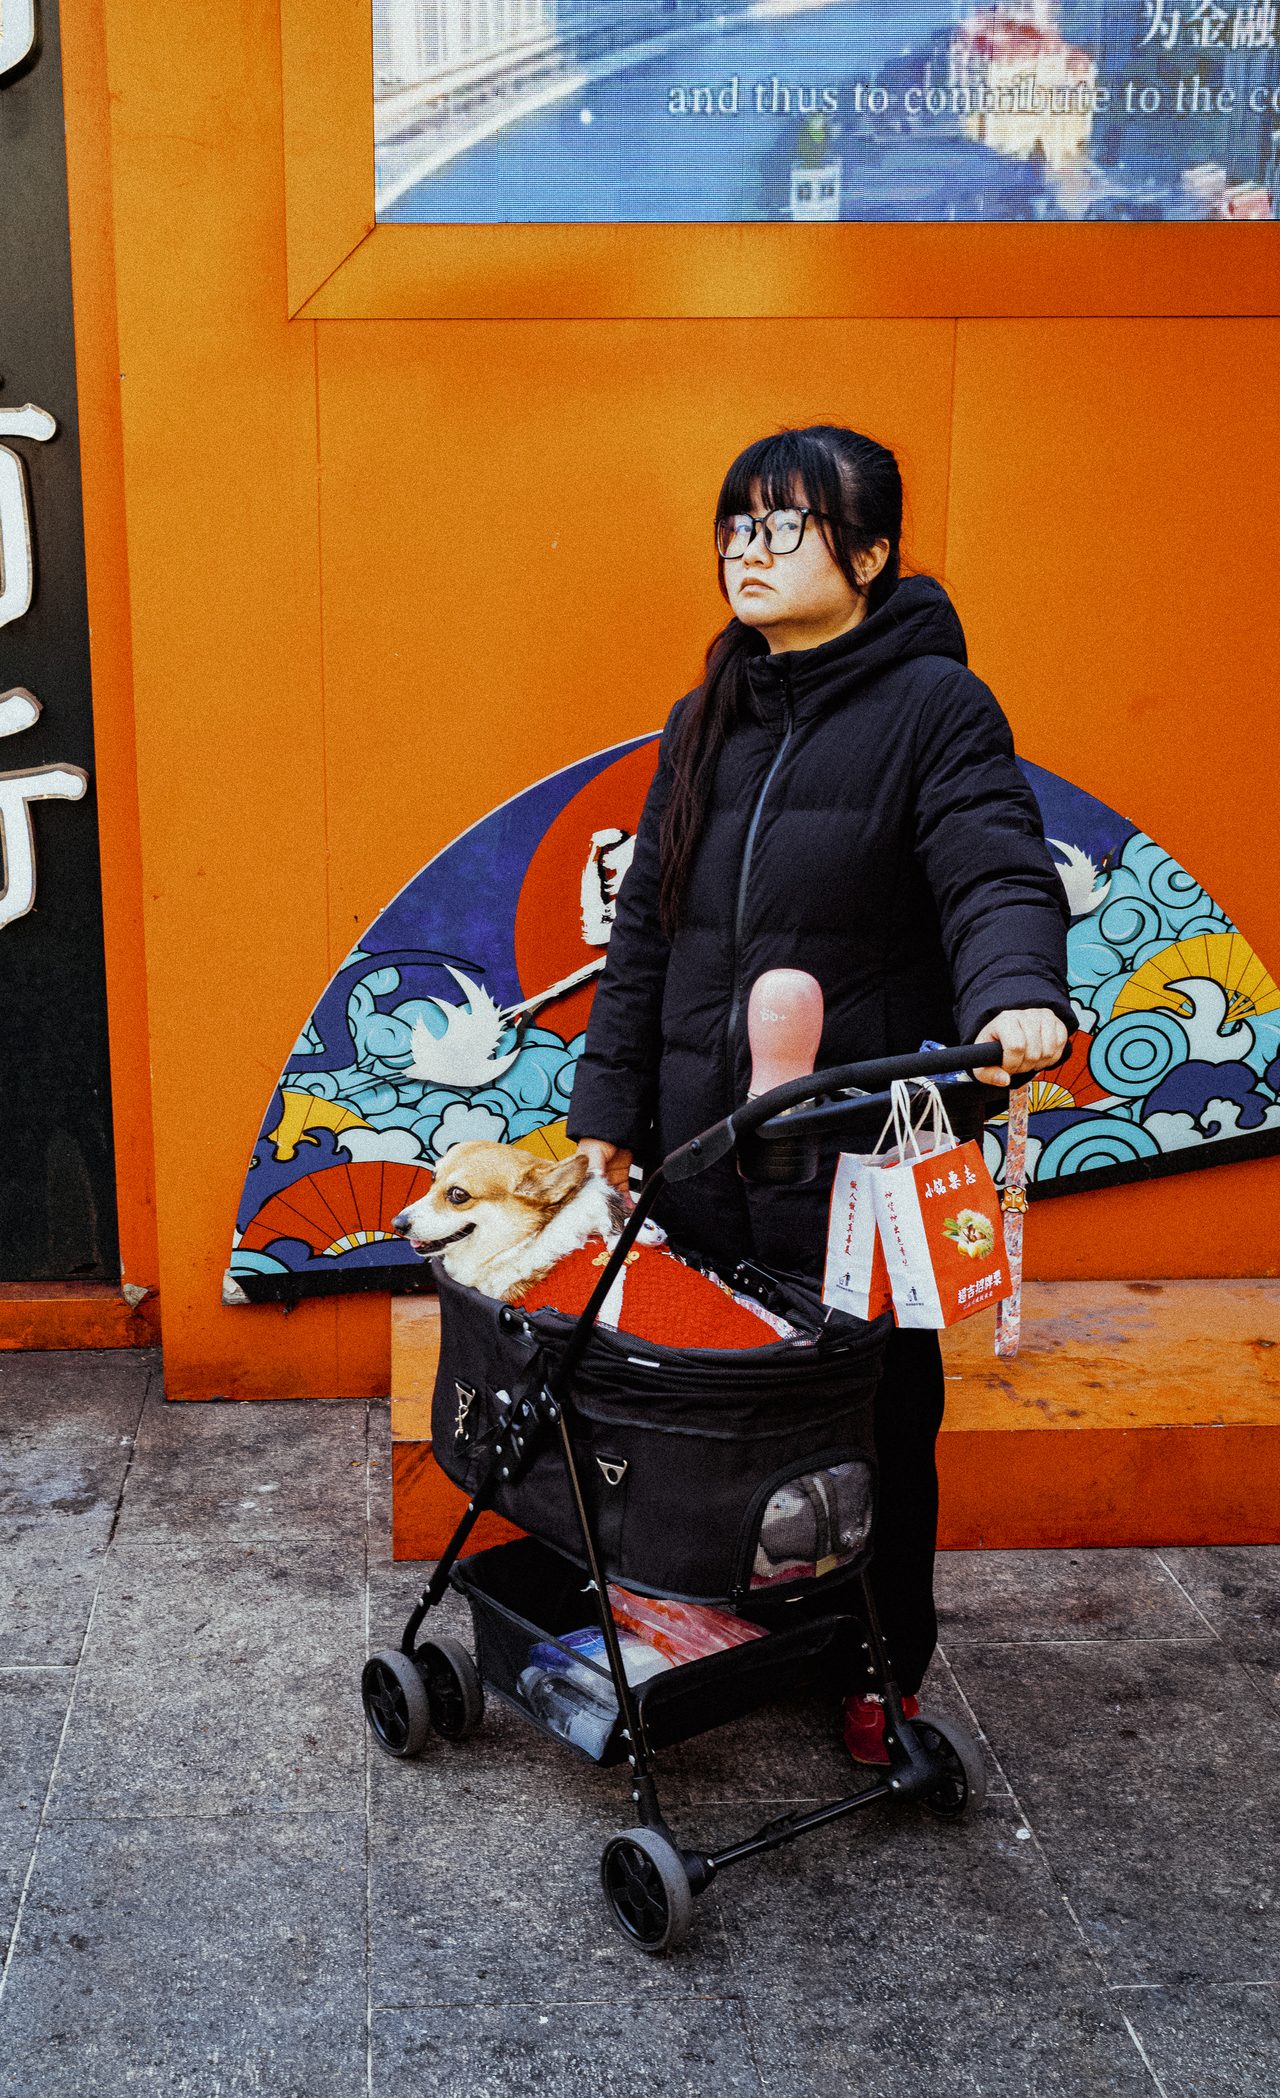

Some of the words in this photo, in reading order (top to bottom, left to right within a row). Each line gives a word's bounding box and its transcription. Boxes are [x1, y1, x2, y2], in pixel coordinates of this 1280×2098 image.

[668, 76, 739, 114] and
[755, 77, 838, 113] thus
[854, 82, 889, 113] to
[904, 78, 1110, 114] contribute
[1125, 81, 1160, 113] to
[1177, 75, 1234, 112] the
